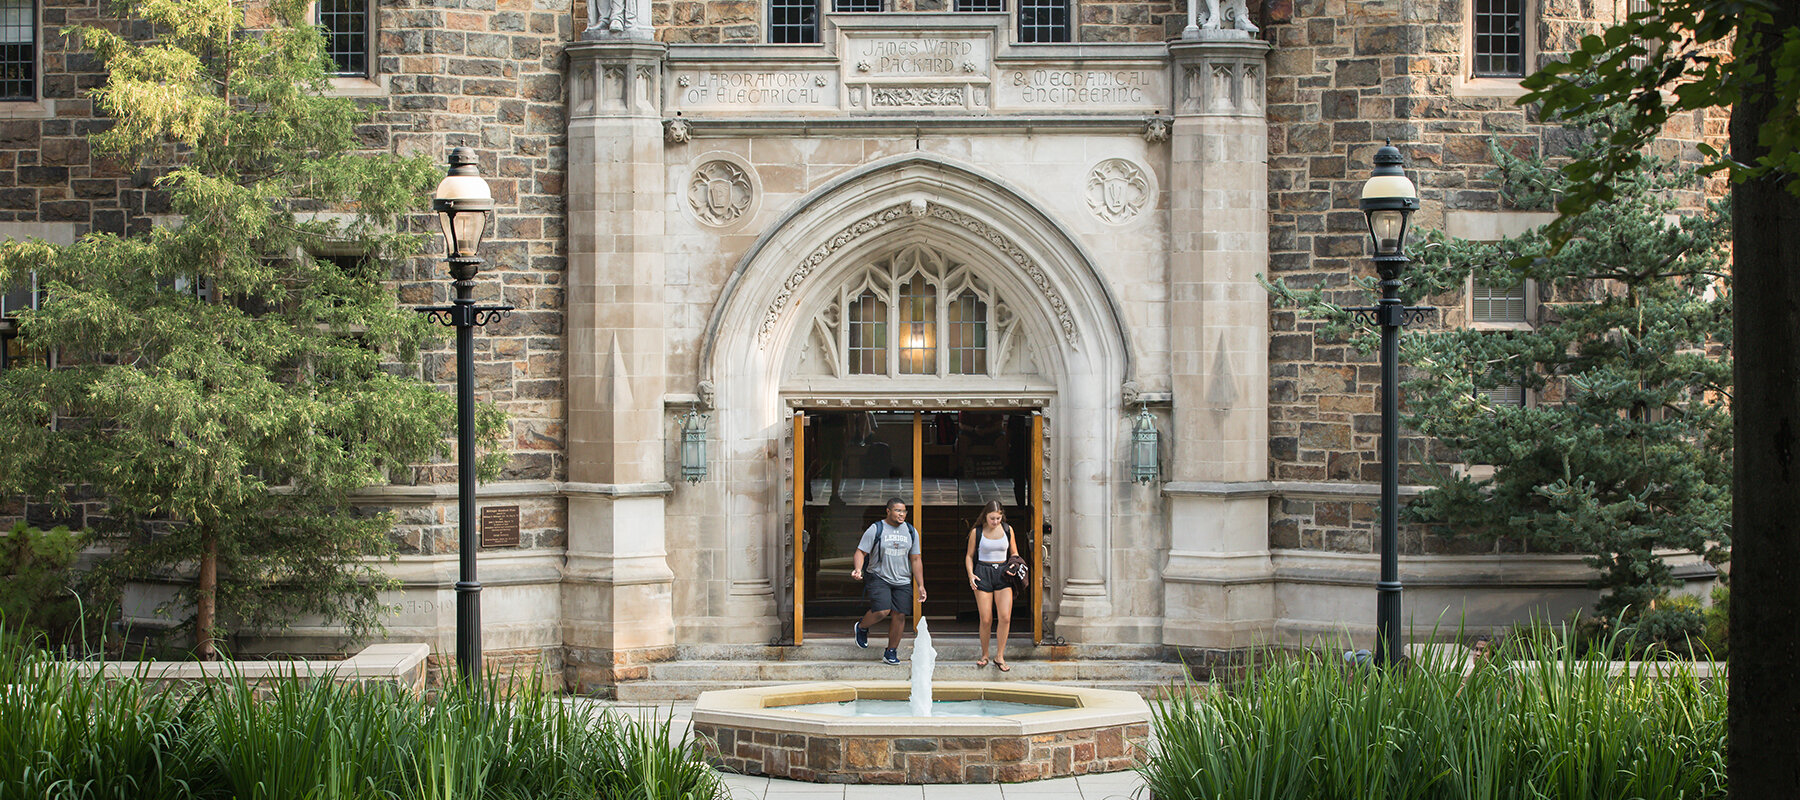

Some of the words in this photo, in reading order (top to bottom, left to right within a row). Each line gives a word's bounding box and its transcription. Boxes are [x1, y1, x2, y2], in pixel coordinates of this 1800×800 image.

[863, 39, 919, 57] JAMES
[923, 38, 973, 56] WARD
[880, 57, 954, 73] PACKARD
[698, 70, 810, 88] LABORATORY
[1013, 71, 1031, 87] &
[1035, 70, 1151, 88] MECHANICAL
[688, 89, 708, 104] OF
[716, 87, 820, 104] ELECTRICAL
[1022, 87, 1143, 103] ENGINEERING
